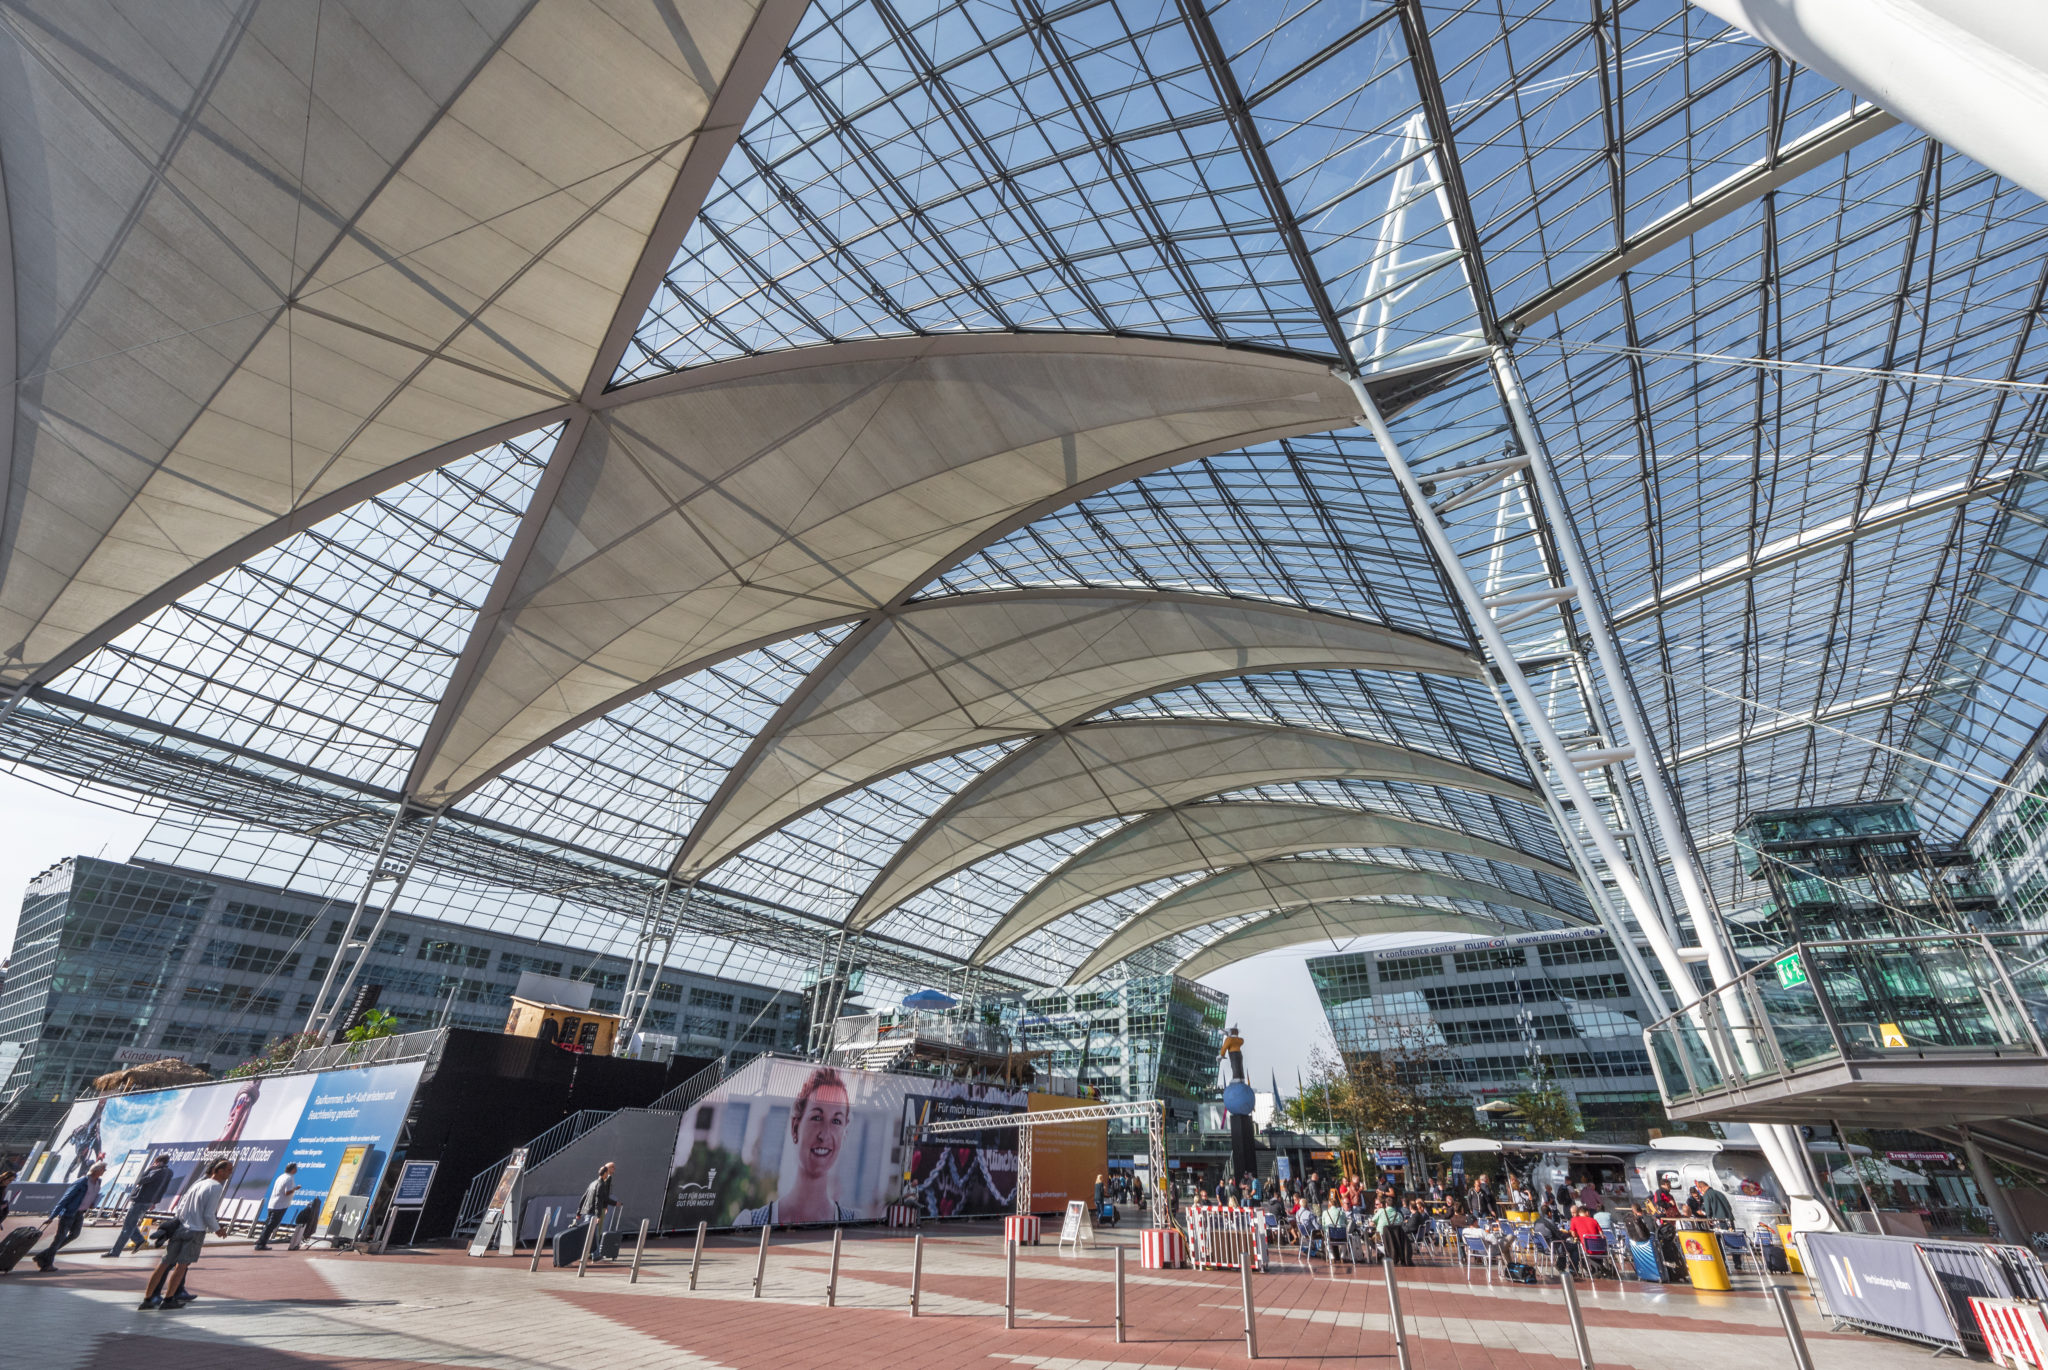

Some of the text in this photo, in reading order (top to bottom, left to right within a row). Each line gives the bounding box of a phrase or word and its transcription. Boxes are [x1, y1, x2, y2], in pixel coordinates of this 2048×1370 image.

[1386, 929, 1596, 959] conference center municon www.municon.de
[949, 1104, 966, 1114] mich
[966, 1106, 976, 1115] ein
[247, 1146, 274, 1162] Oktober
[688, 1191, 698, 1200] FÜR
[687, 1199, 697, 1207] FÜR
